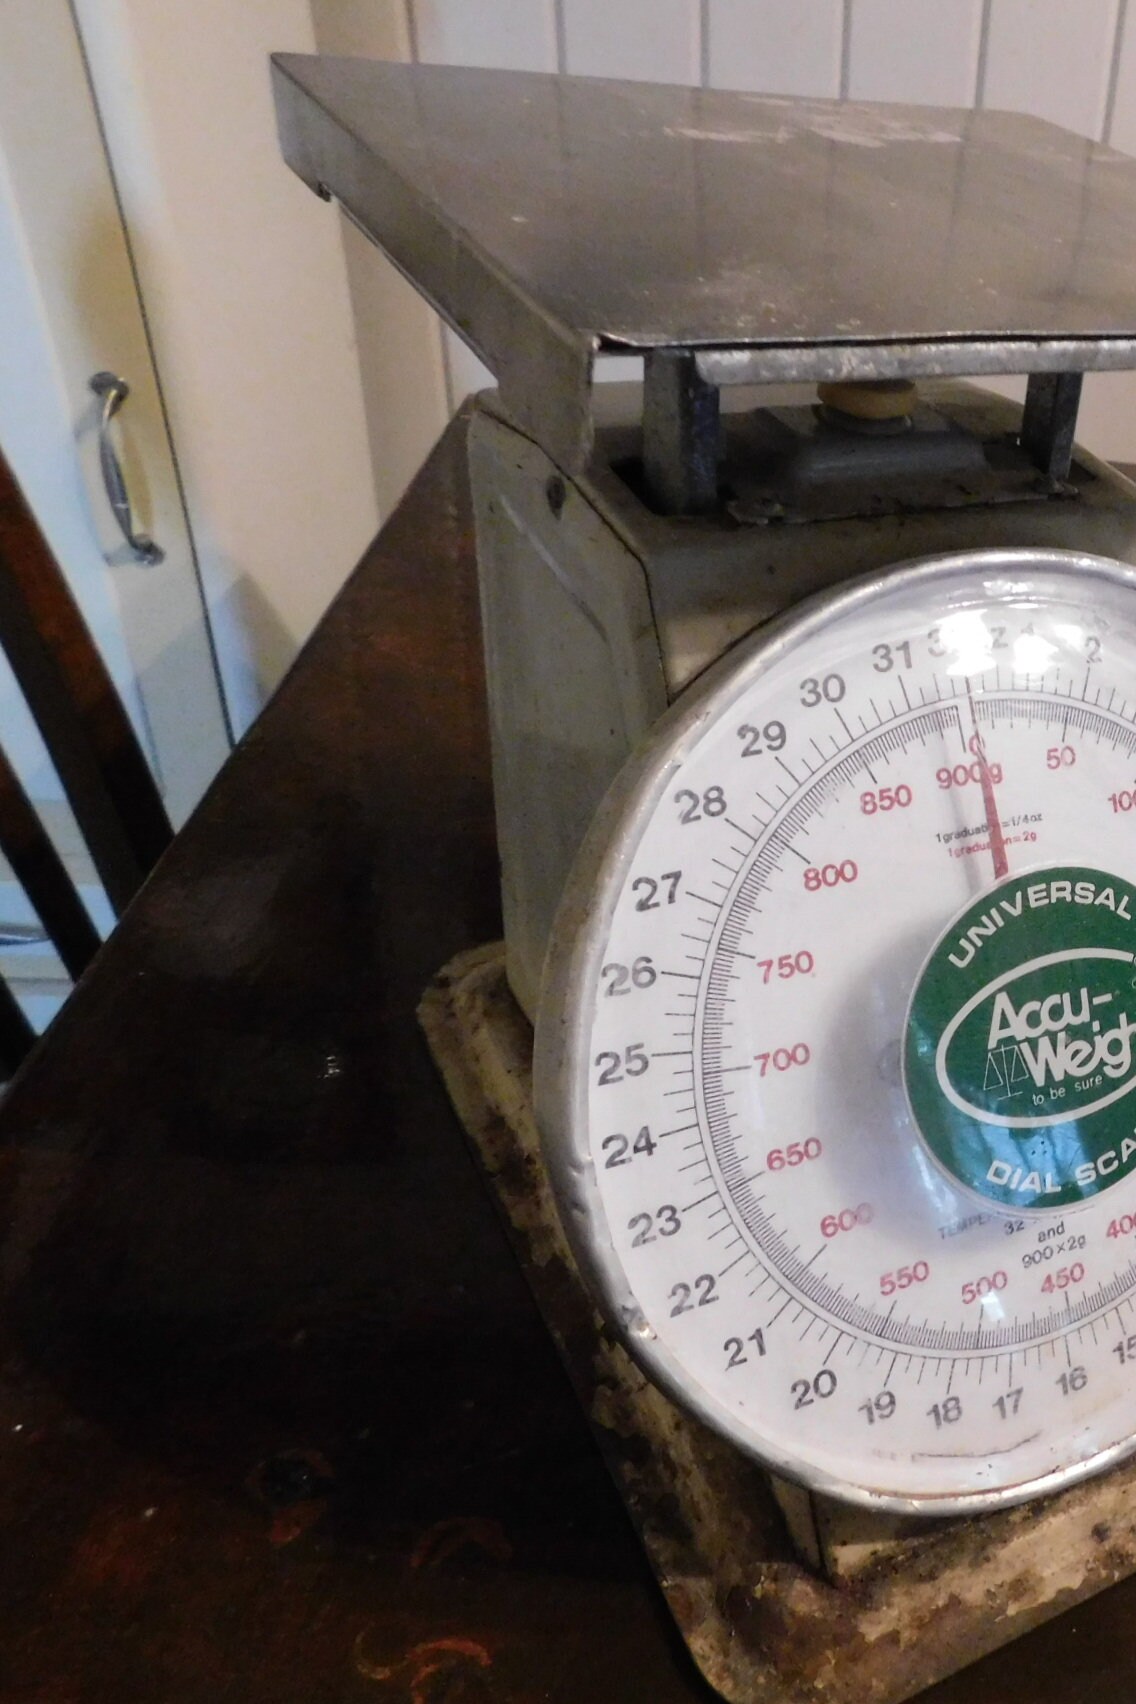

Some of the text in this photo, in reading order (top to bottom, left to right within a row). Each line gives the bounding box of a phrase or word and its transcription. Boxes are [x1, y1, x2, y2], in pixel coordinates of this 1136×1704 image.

[872, 641, 913, 673] 31
[1085, 636, 1102, 663] 2
[800, 674, 846, 707] 30
[737, 721, 787, 758] 29
[1047, 745, 1076, 770] 50
[674, 786, 727, 825] 28
[859, 784, 913, 815] 850
[632, 870, 682, 912] 27
[803, 859, 858, 891] 800
[948, 881, 1132, 968] UNIVERSAL
[601, 956, 657, 998] 26
[757, 950, 814, 985] 750
[987, 987, 1112, 1050] Accu-
[595, 1043, 649, 1086] 25
[754, 1043, 810, 1077] 700
[1032, 1074, 1103, 1106] to be sure
[602, 1126, 657, 1169] 24
[767, 1137, 822, 1171] 650
[986, 1160, 1061, 1193] DIAL
[627, 1204, 682, 1249] 23
[820, 1202, 874, 1238] 600
[1038, 1221, 1065, 1243] and
[880, 1261, 930, 1296] 550
[961, 1271, 1008, 1305] 500
[1041, 1262, 1085, 1294] 450
[667, 1274, 719, 1318] 22
[724, 1328, 766, 1371] 21
[791, 1369, 837, 1410] 20
[1055, 1366, 1088, 1396] 16
[858, 1391, 896, 1425] 19
[926, 1396, 963, 1429] 18
[992, 1387, 1024, 1420] 17
